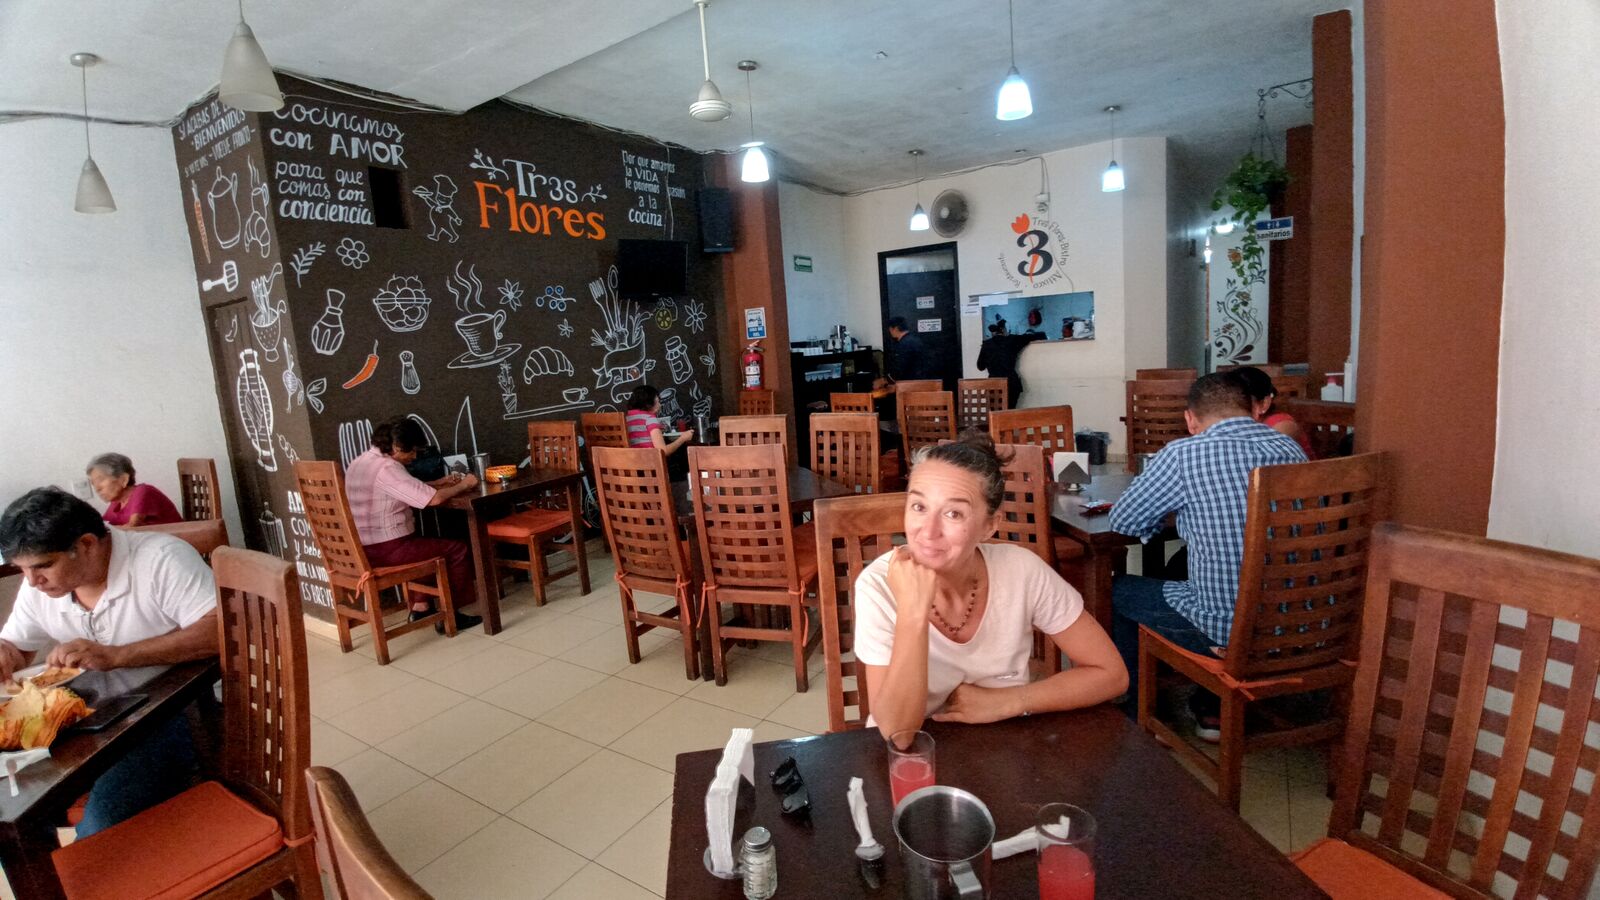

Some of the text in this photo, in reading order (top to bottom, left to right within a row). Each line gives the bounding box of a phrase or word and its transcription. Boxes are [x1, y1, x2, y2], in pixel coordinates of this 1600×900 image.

[270, 128, 409, 169] con AMOR
[622, 149, 636, 166] Por
[637, 156, 649, 169] que
[275, 161, 364, 187] para que
[624, 177, 632, 190] le
[625, 165, 660, 184] la VIDA
[278, 179, 367, 202] comas con
[638, 194, 658, 210] a la
[279, 199, 375, 226] conciencia
[473, 180, 607, 241] Flores
[1256, 230, 1291, 239] sanitarios
[1017, 229, 1053, 276] 3
[288, 490, 305, 514] AM
[291, 517, 316, 539] COM
